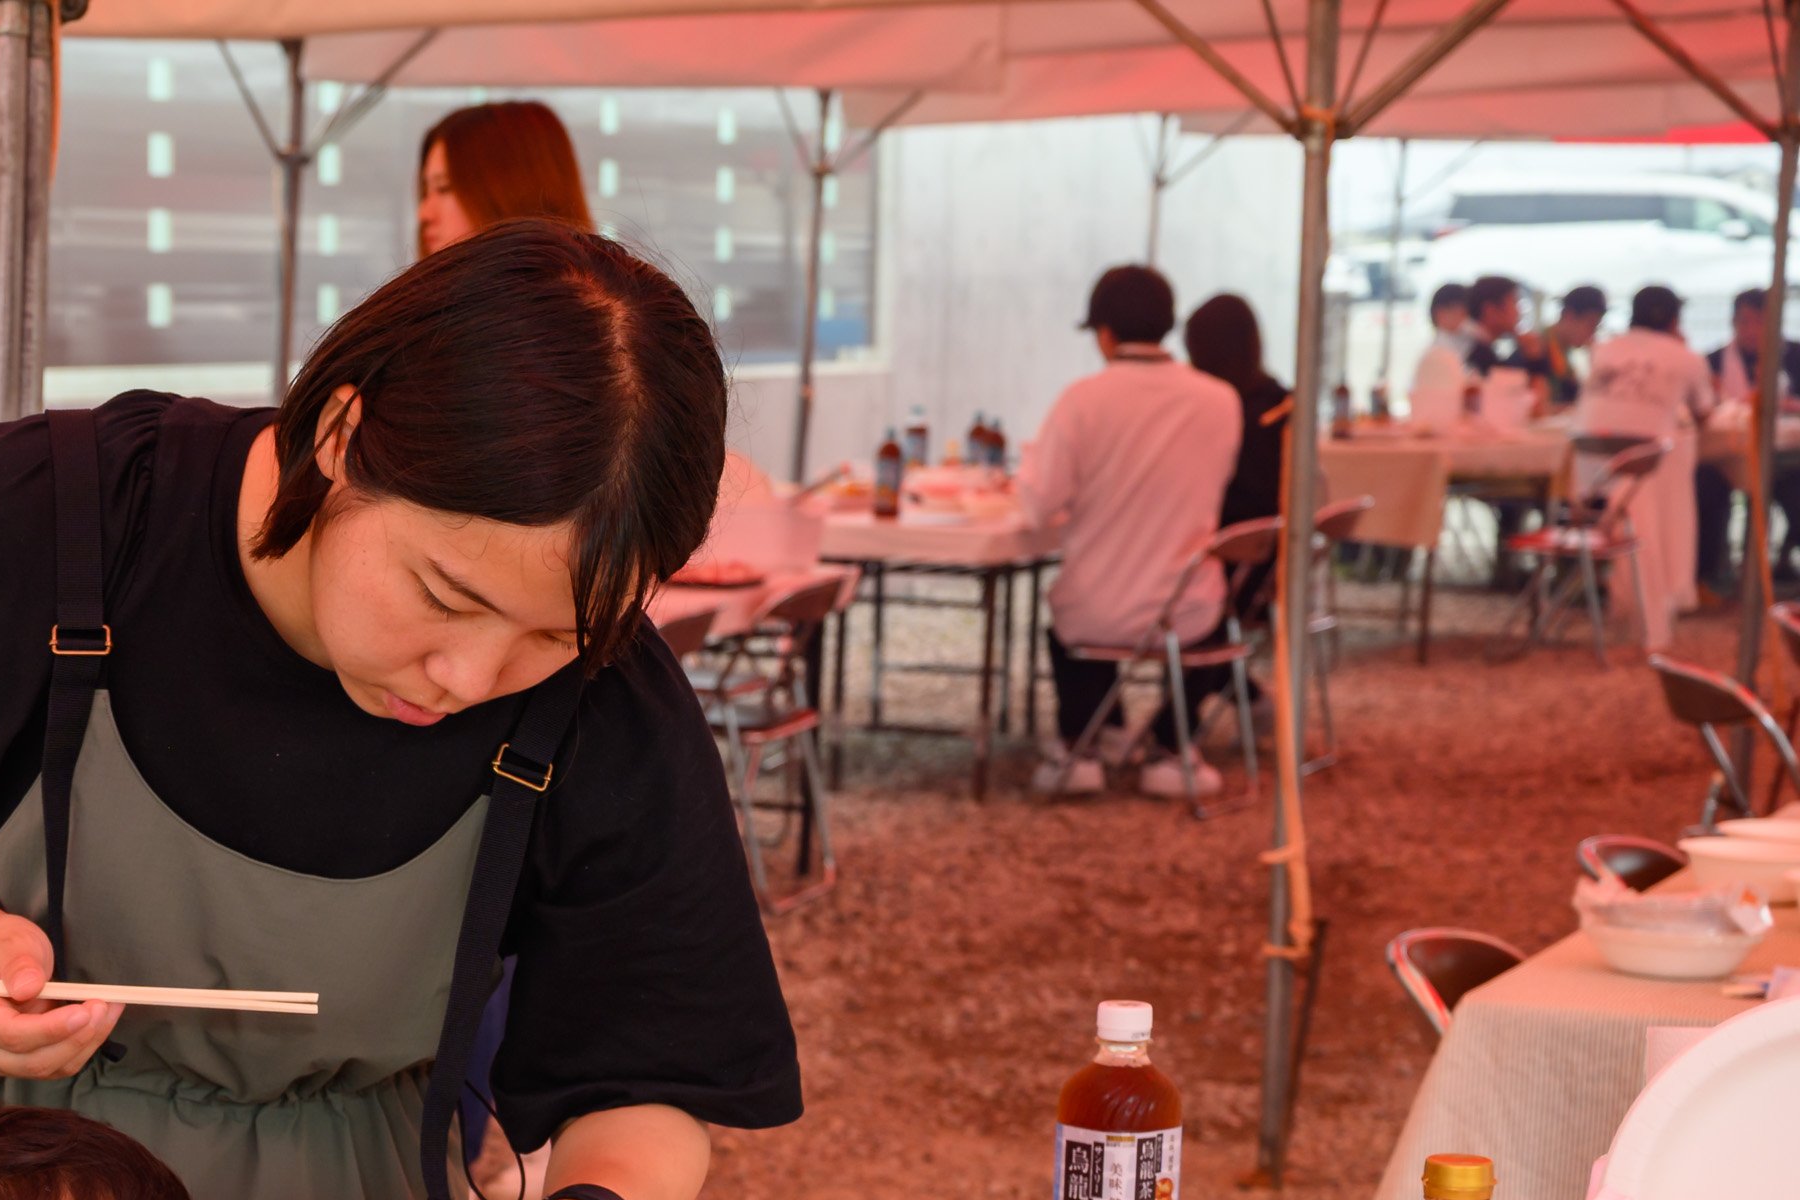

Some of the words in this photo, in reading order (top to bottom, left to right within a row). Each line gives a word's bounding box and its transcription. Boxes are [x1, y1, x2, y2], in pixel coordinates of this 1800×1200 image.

[1094, 1145, 1103, 1194] サントリー
[1138, 1140, 1154, 1199] 烏龍茶
